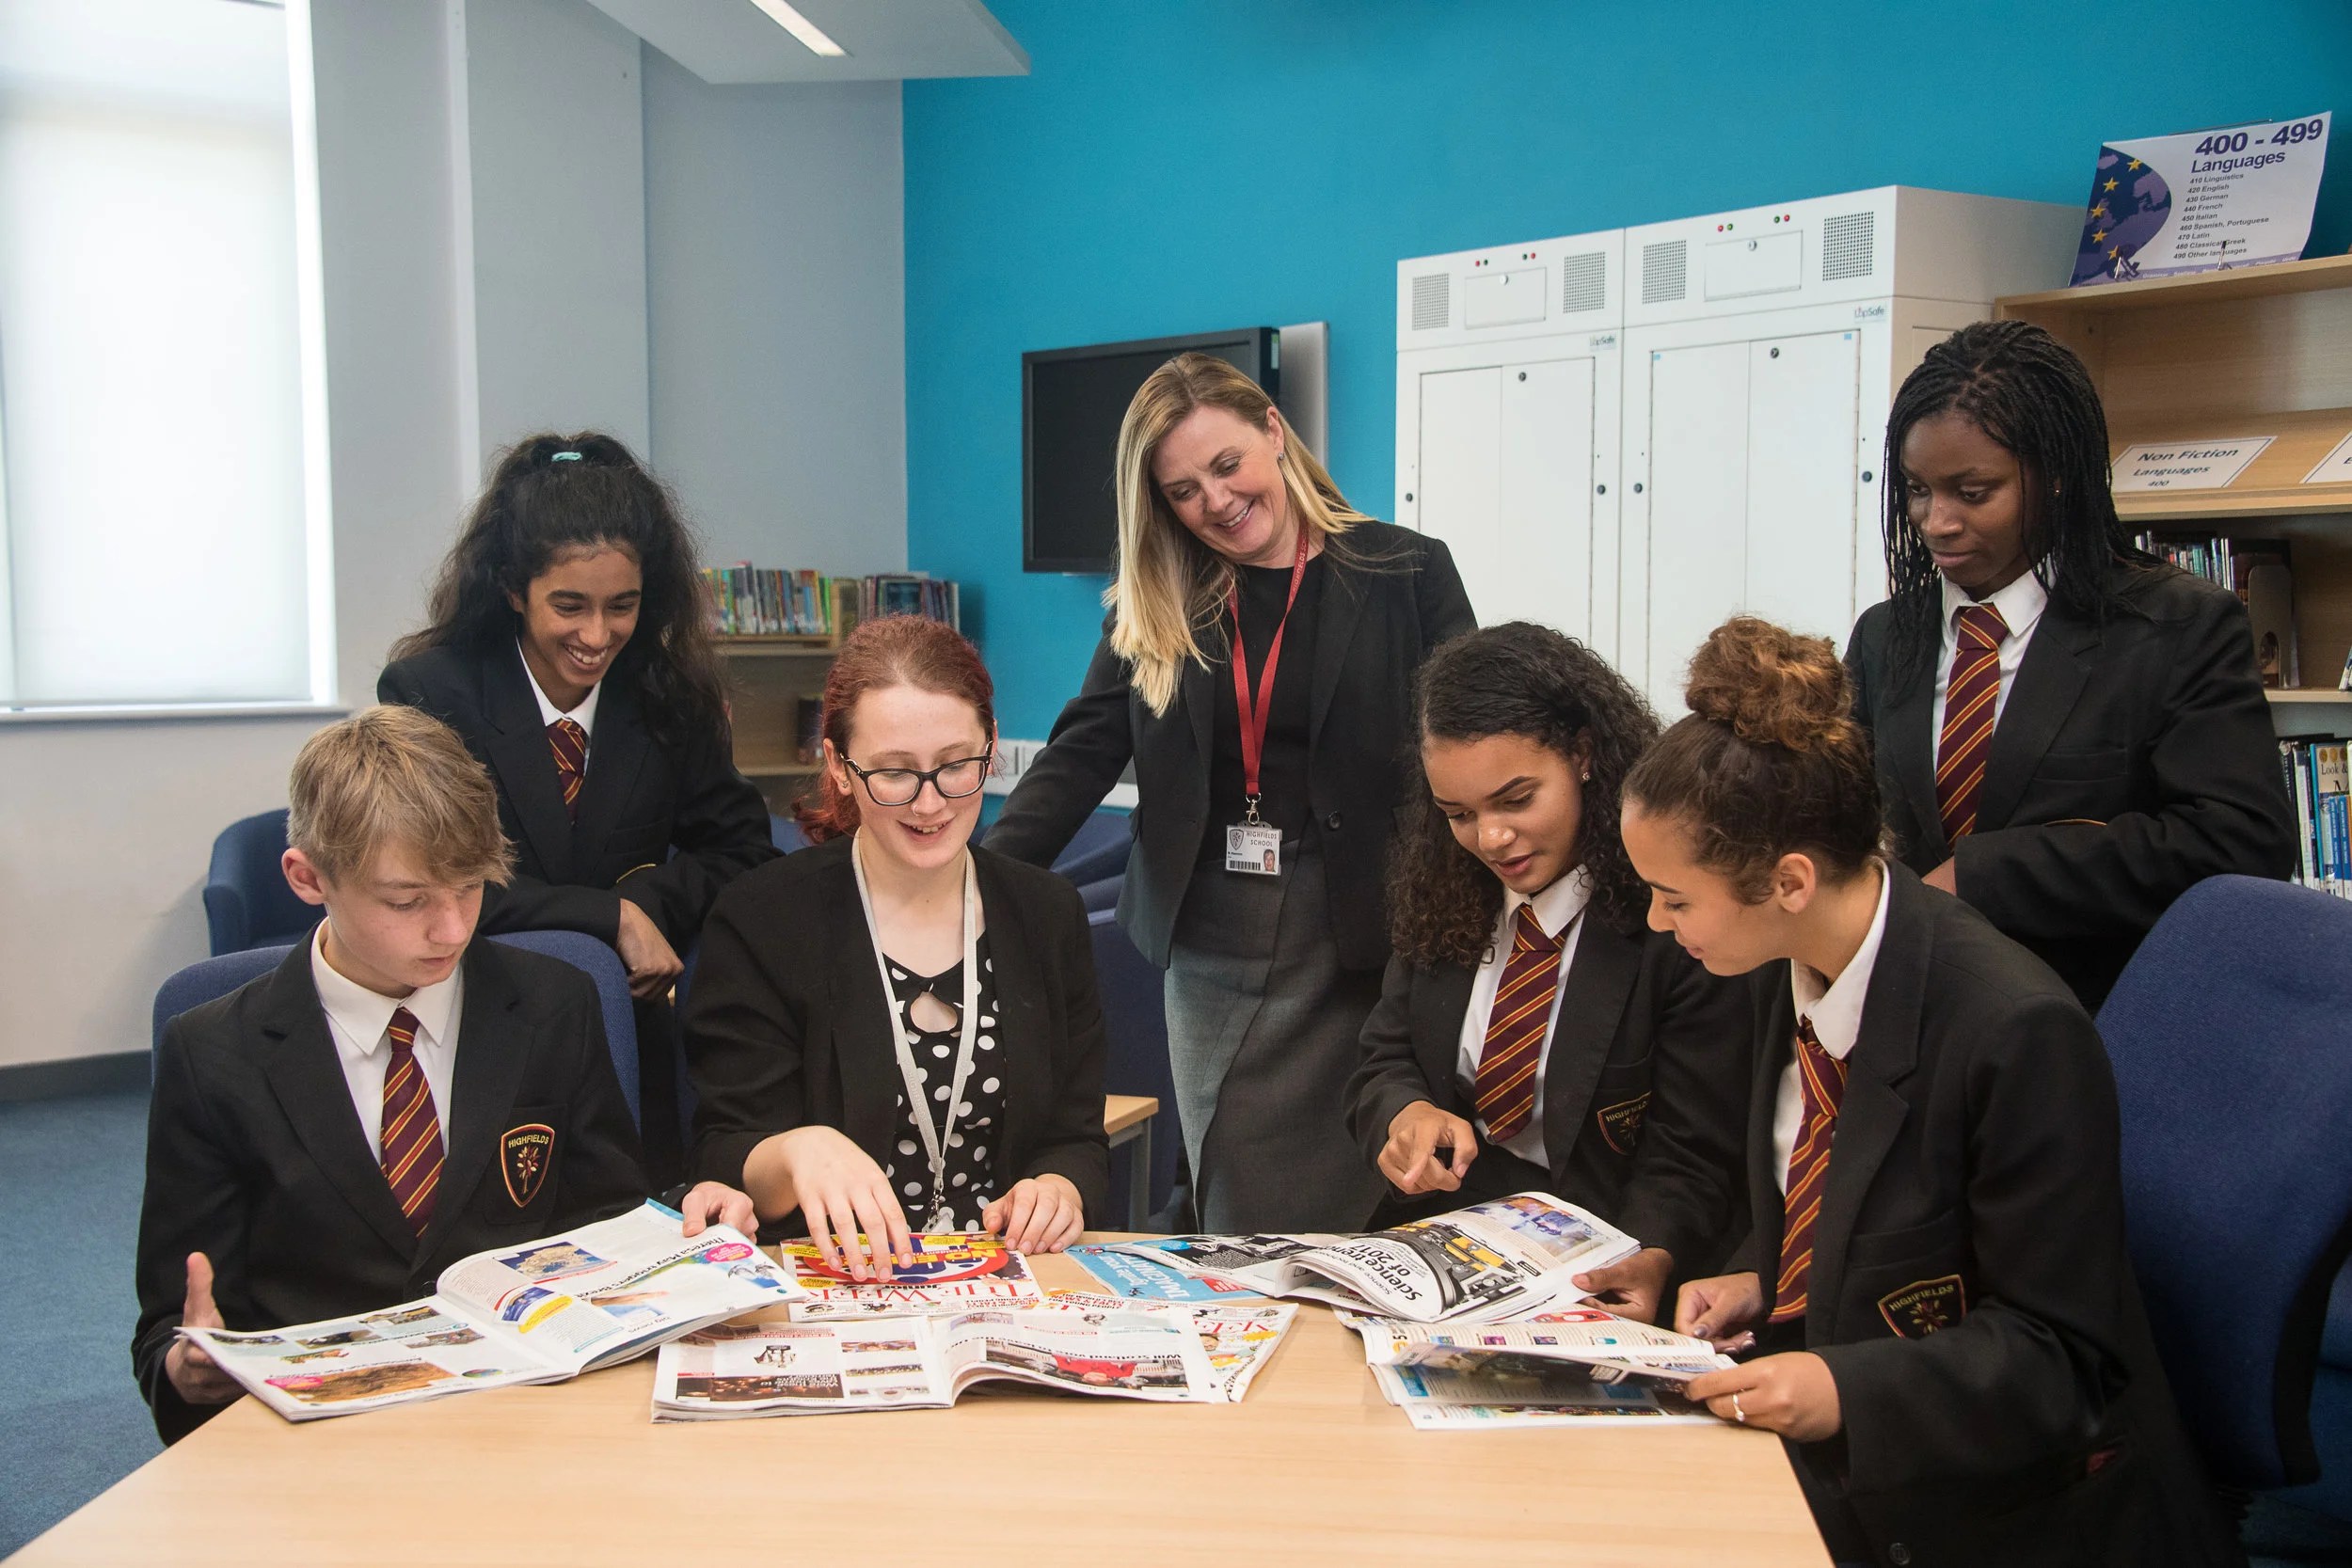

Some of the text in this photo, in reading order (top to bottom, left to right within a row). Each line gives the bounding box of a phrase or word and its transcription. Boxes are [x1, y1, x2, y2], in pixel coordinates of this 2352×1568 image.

[2194, 132, 2248, 156] 400
[2270, 119, 2324, 146] 499
[2190, 151, 2285, 175] Languages
[2203, 172, 2245, 184] Linguistics
[2201, 183, 2230, 194] English
[2200, 193, 2229, 201] German
[2198, 202, 2223, 212] French
[2195, 212, 2217, 221] Italian
[2193, 221, 2226, 231] Spanish,
[2227, 216, 2269, 228] Portuguese
[2191, 231, 2210, 240] Latin
[2187, 249, 2208, 259] Other
[2137, 448, 2239, 463] Non Fiction
[2133, 466, 2211, 477] Languages
[2147, 479, 2170, 487] 400
[2321, 763, 2339, 776] Look
[1246, 831, 1277, 840] HIGHFIELDS
[1250, 839, 1273, 847] SCHOOL
[508, 1133, 549, 1148] HIGHFIELDS
[680, 1237, 727, 1255] Theresa
[656, 1253, 680, 1266] May
[945, 1248, 997, 1260] NO
[1349, 1244, 1411, 1276] of 2017
[1365, 1258, 1422, 1301] Science
[1365, 1271, 1392, 1295] Science
[1888, 1284, 1954, 1311] HIGHFIELDS
